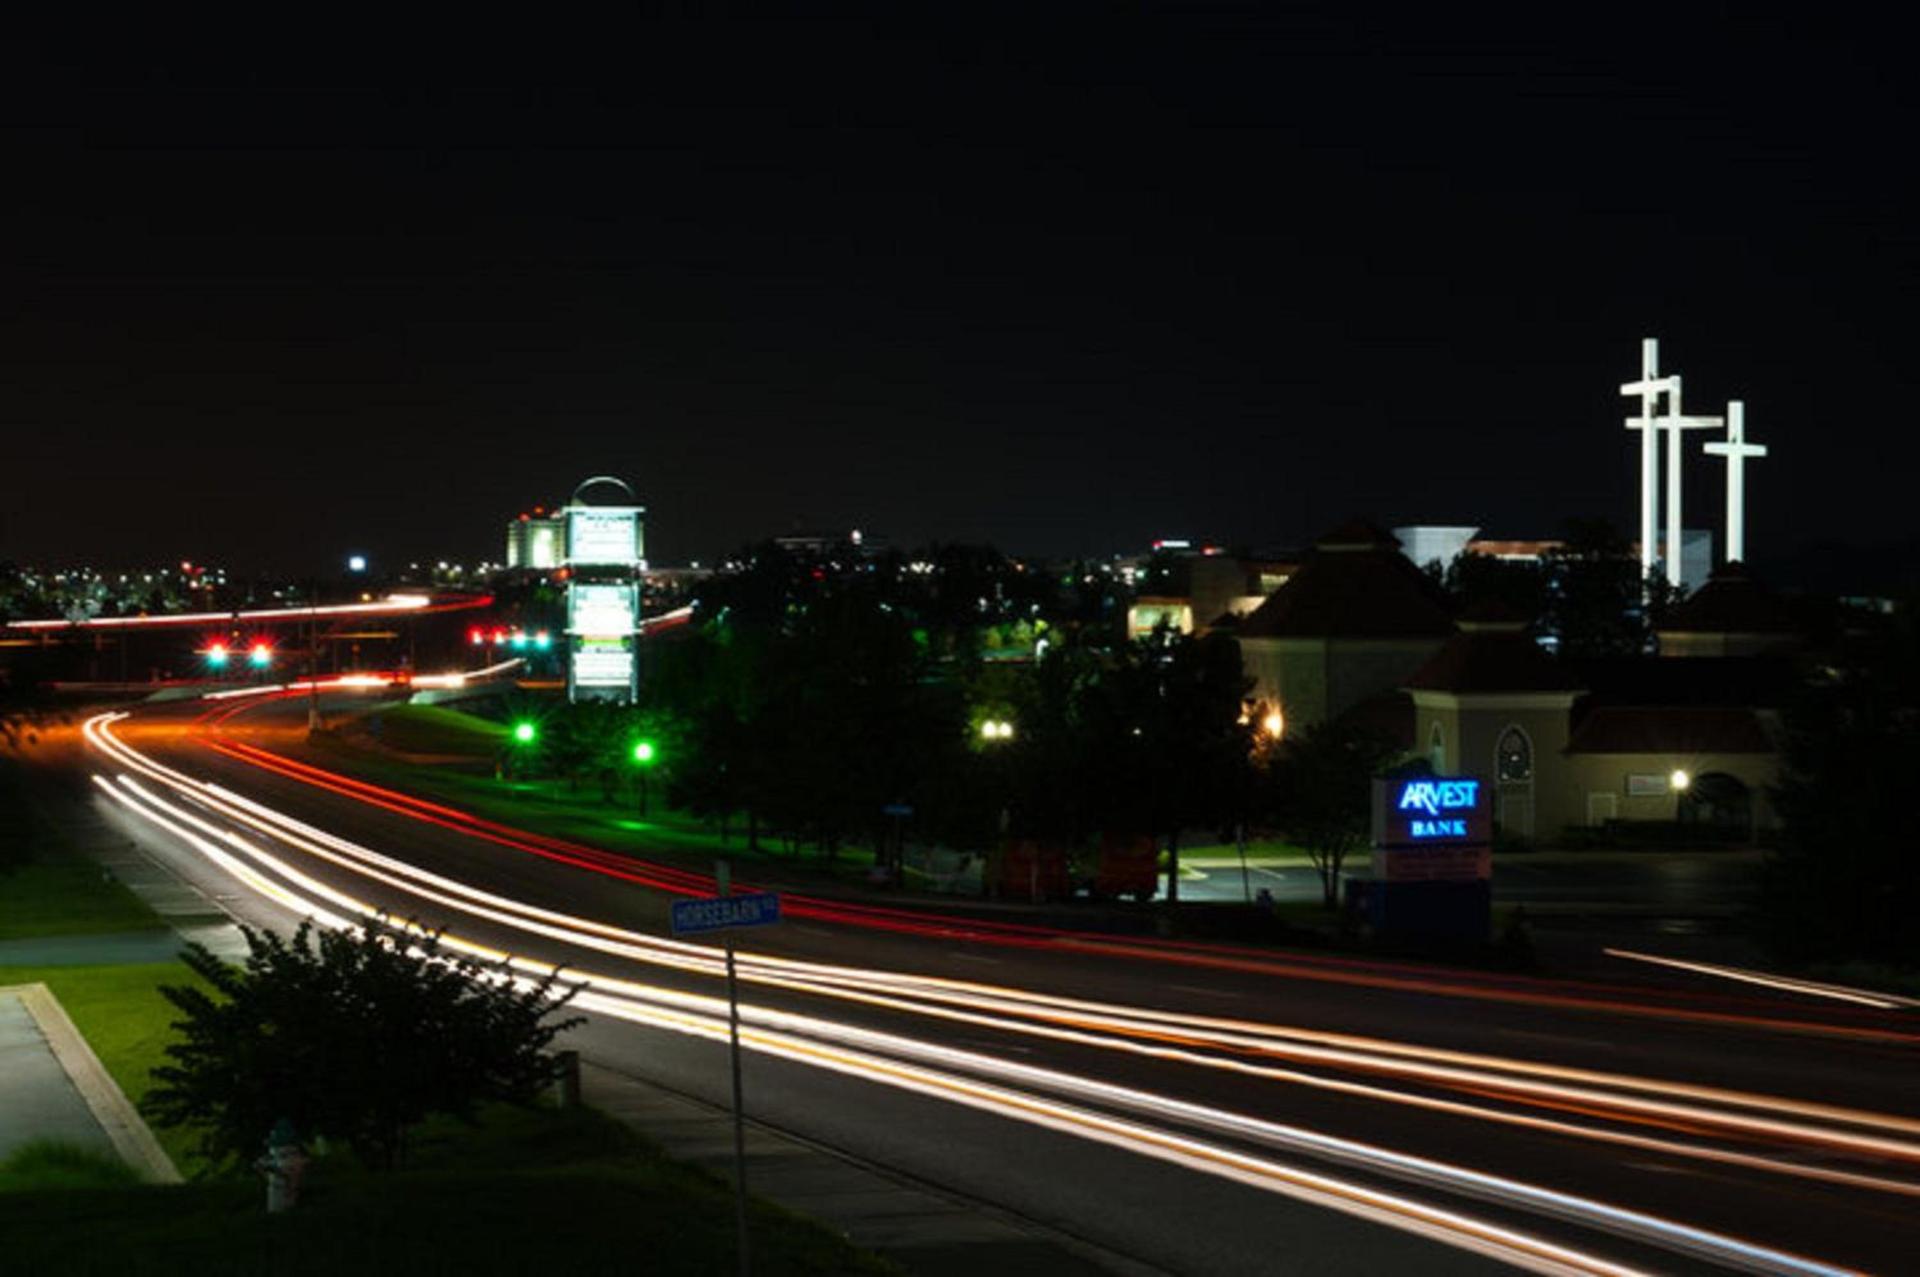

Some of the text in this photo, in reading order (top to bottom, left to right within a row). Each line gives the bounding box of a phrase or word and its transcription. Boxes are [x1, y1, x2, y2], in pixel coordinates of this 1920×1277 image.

[1400, 781, 1478, 815] ARVEST
[1411, 819, 1467, 837] BANK
[676, 899, 761, 928] HORSEBARN
